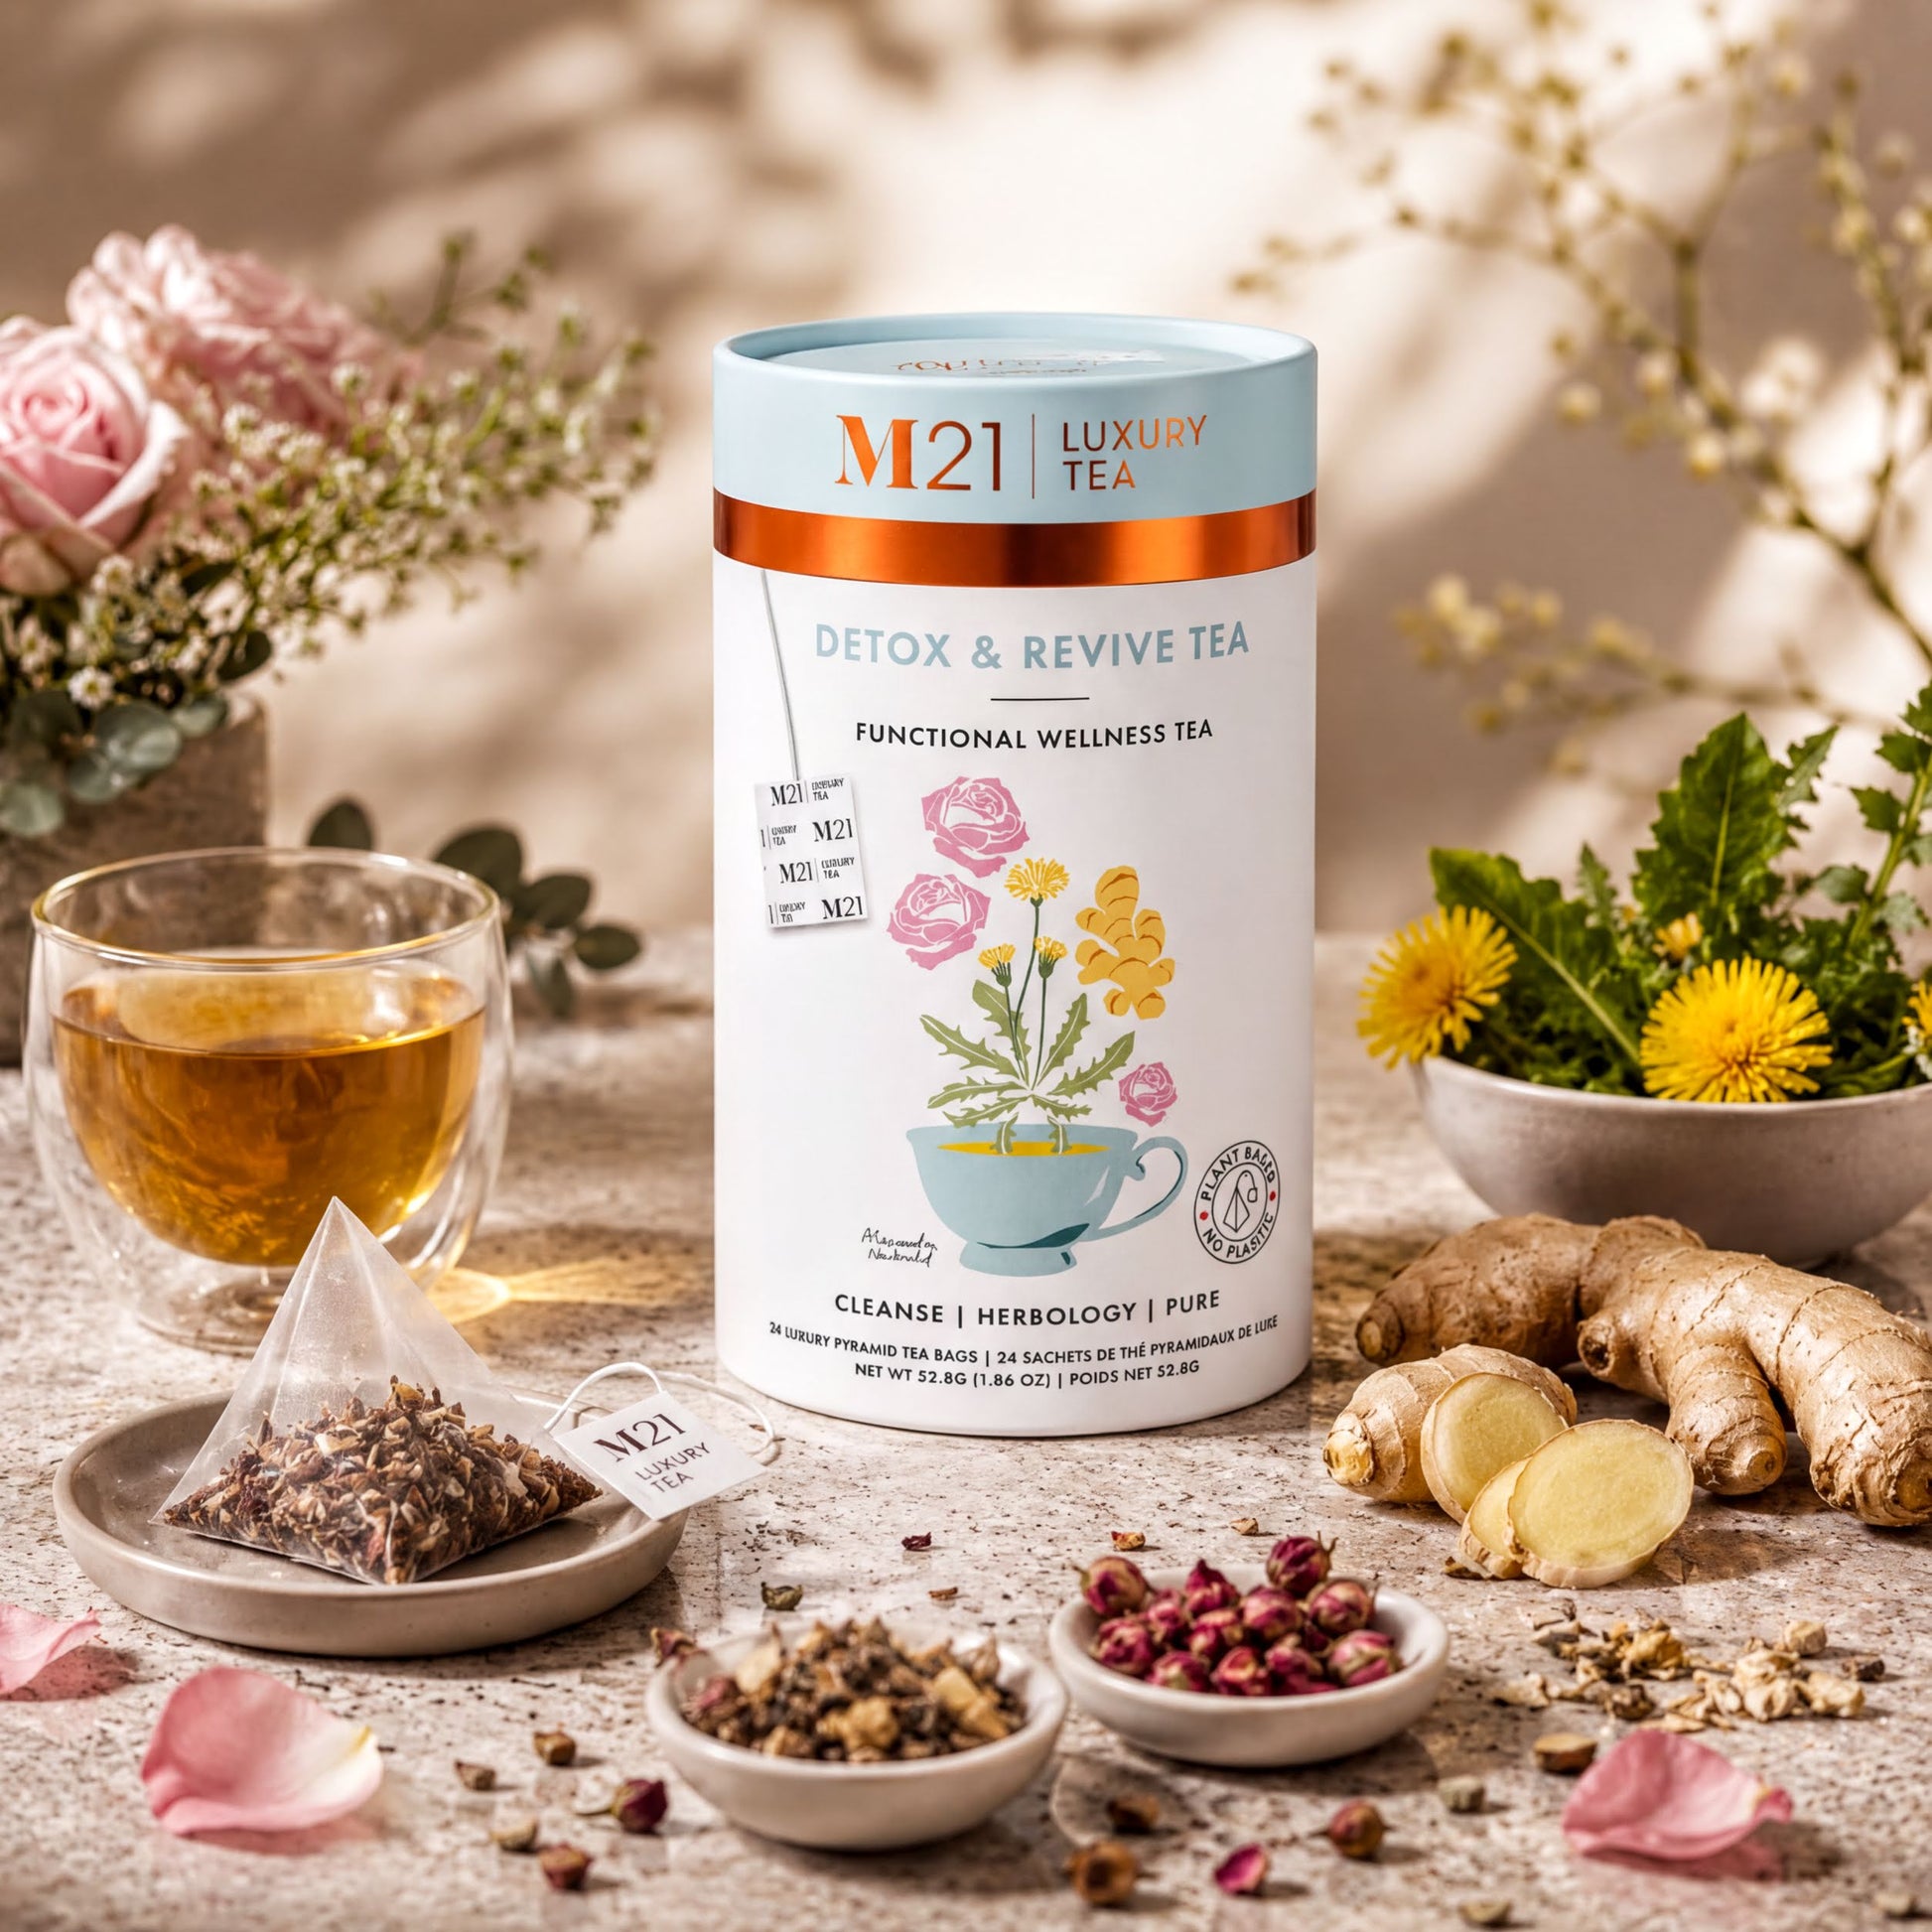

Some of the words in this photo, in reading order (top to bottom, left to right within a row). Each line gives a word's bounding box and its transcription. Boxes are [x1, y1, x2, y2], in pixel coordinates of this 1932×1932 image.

[1062, 414, 1207, 453] LUXURY
[834, 414, 1001, 491] M21
[1062, 460, 1137, 490] TEA
[815, 623, 951, 668] DETOX
[971, 634, 1002, 669] &
[1023, 628, 1174, 669] REVIVE
[1188, 621, 1249, 660] TEA
[856, 722, 1027, 750] FUNCTIONAL
[1036, 724, 1166, 749] WELLNESS
[1174, 719, 1213, 741] TEA
[769, 782, 803, 807] M21
[812, 818, 854, 843] M21
[778, 861, 813, 885] M21
[821, 896, 864, 920] M21
[1199, 1148, 1239, 1202] PLANT
[1202, 1227, 1223, 1252] NO
[834, 1294, 944, 1323] CLEANSE
[978, 1302, 1137, 1326] HERBOLOGY
[1166, 1290, 1220, 1316] PURE
[769, 1321, 781, 1335] 24
[834, 1336, 897, 1358] PYRAMID
[901, 1345, 929, 1361] TEA
[934, 1349, 978, 1364] BAGS
[997, 1350, 1018, 1364] 24
[1023, 1349, 1092, 1364] SACHETS
[1096, 1347, 1116, 1361] DE
[1119, 1341, 1147, 1359] THÉ
[1150, 1328, 1235, 1356] PYRAMIDAUX
[1238, 1324, 1252, 1339] DE
[855, 1363, 883, 1378] NET
[888, 1366, 912, 1381] WT
[917, 1370, 967, 1385] 52.8G
[973, 1372, 1015, 1388] (1.86
[1020, 1373, 1051, 1388] OZ)
[1069, 1370, 1119, 1386] POIDS
[1124, 1366, 1153, 1382] NET
[1157, 1360, 1200, 1378] 52.8G
[594, 1413, 687, 1463] M21
[634, 1442, 711, 1481] LUXURY
[649, 1471, 694, 1493] TEA
